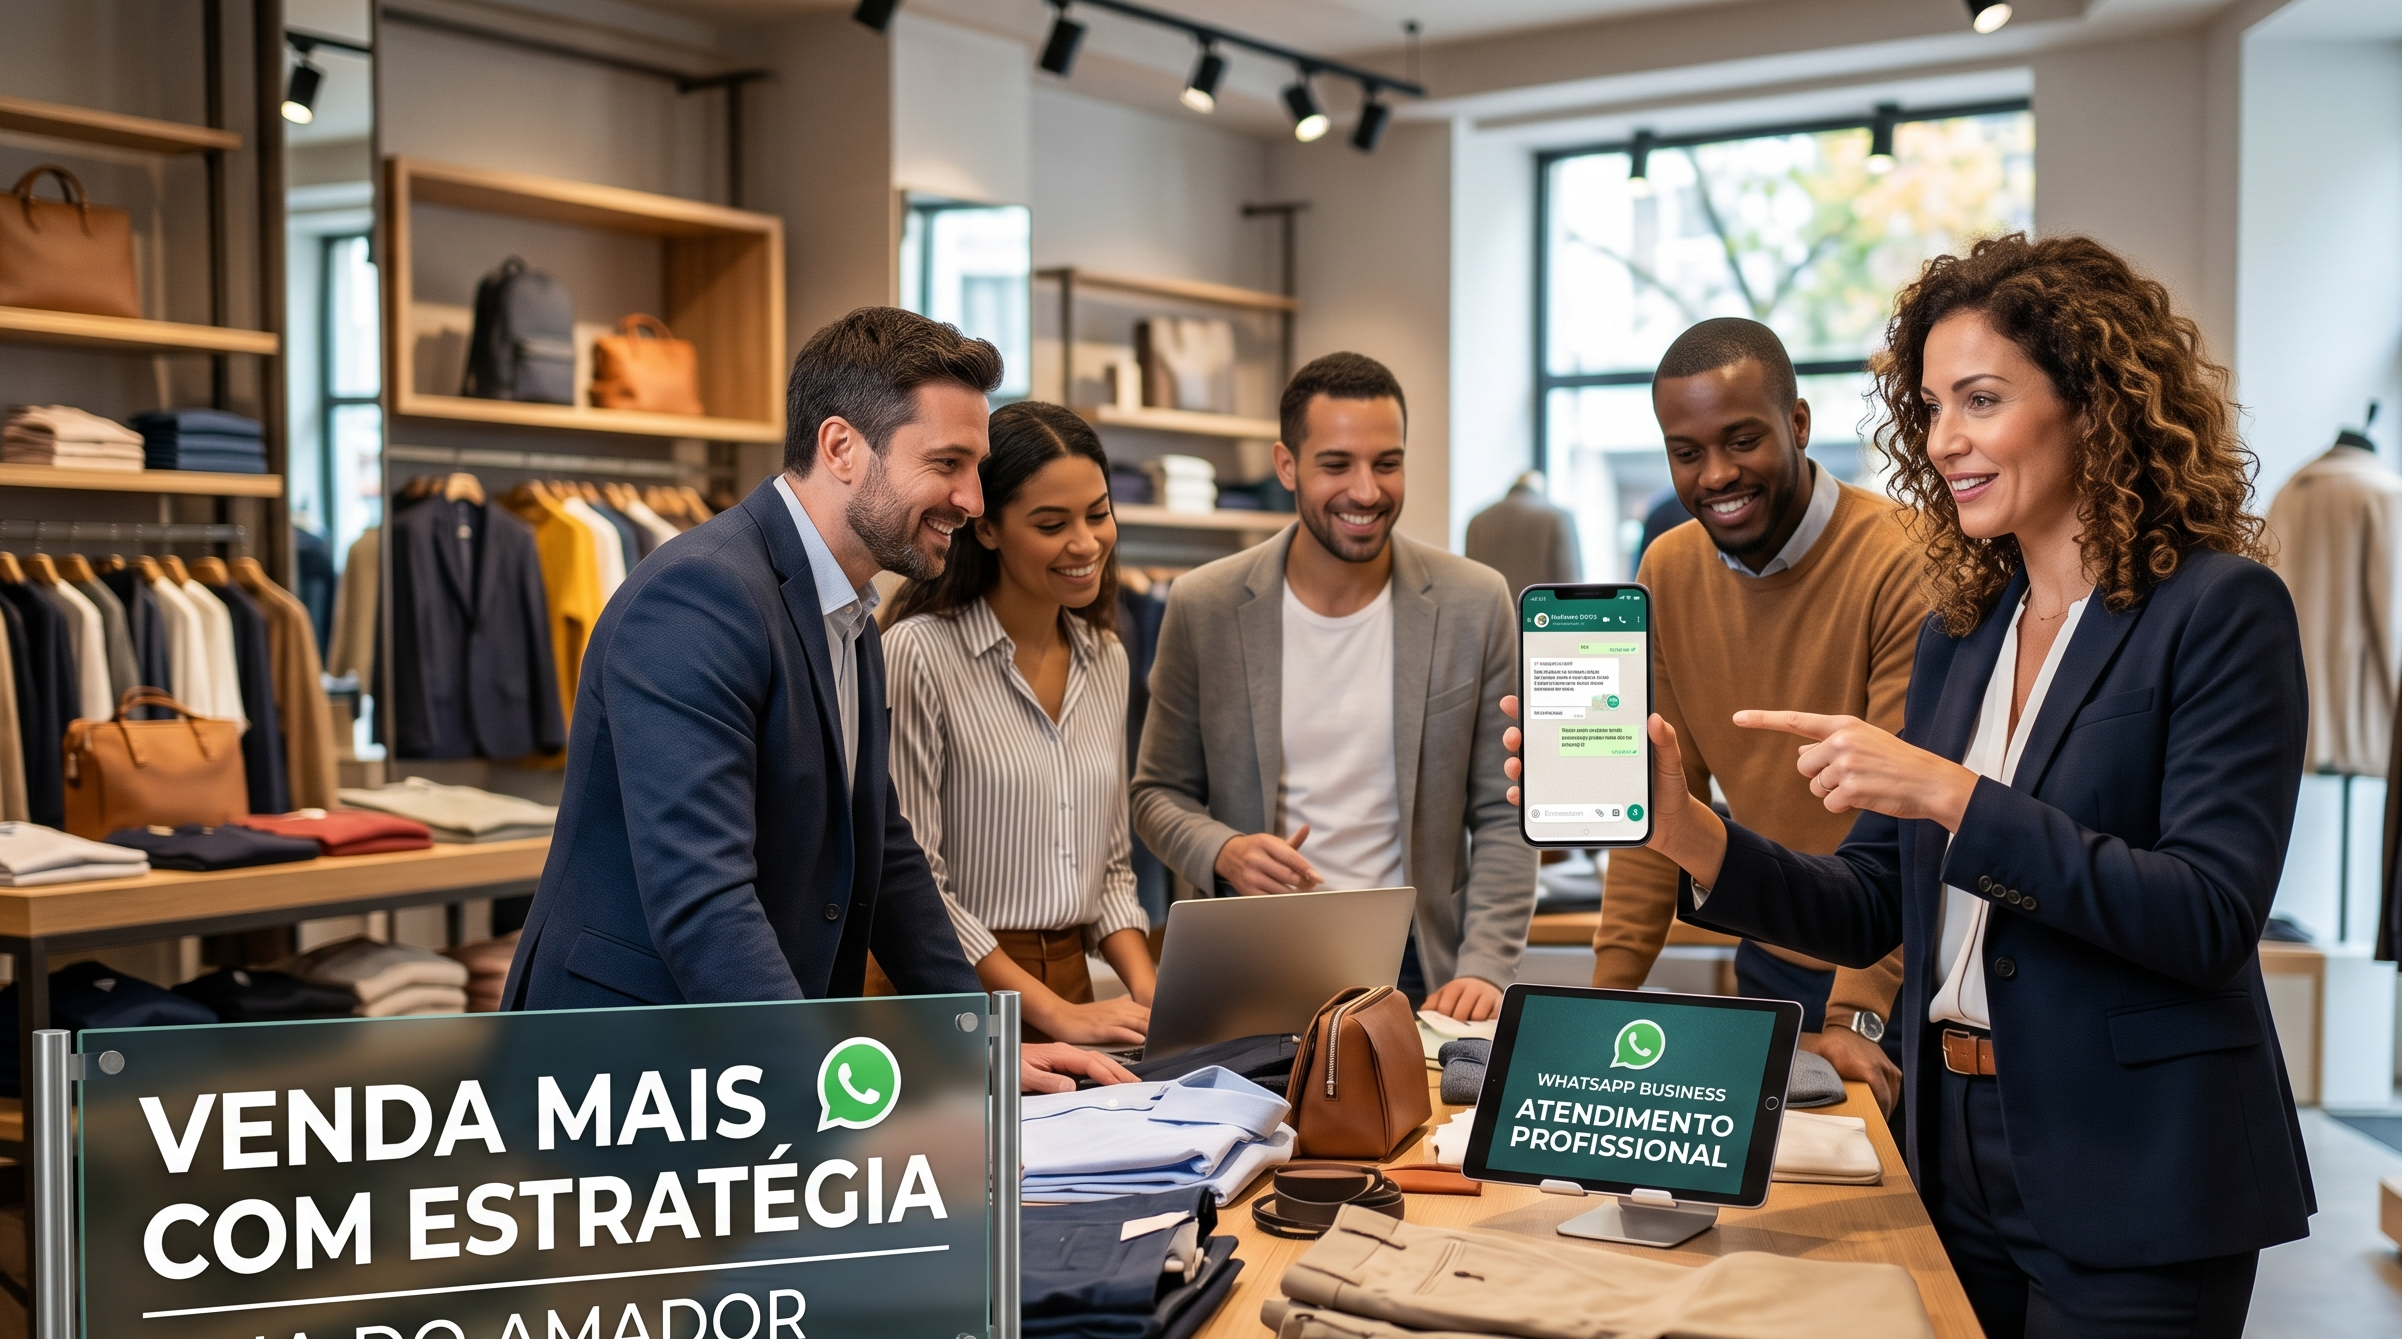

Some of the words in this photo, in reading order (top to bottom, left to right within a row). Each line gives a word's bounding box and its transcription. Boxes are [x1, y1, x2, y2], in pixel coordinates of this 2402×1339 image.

[1538, 1072, 1636, 1094] WHATSAPP
[1639, 1081, 1727, 1102] BUSINESS
[138, 1079, 507, 1175] VENDA
[538, 1064, 767, 1151] MAIS
[1515, 1098, 1734, 1138] ATENDIMENTO
[1510, 1125, 1728, 1168] PROFISSIONAL
[142, 1191, 372, 1281] COM
[409, 1143, 949, 1261] ESTRATÉGIA
